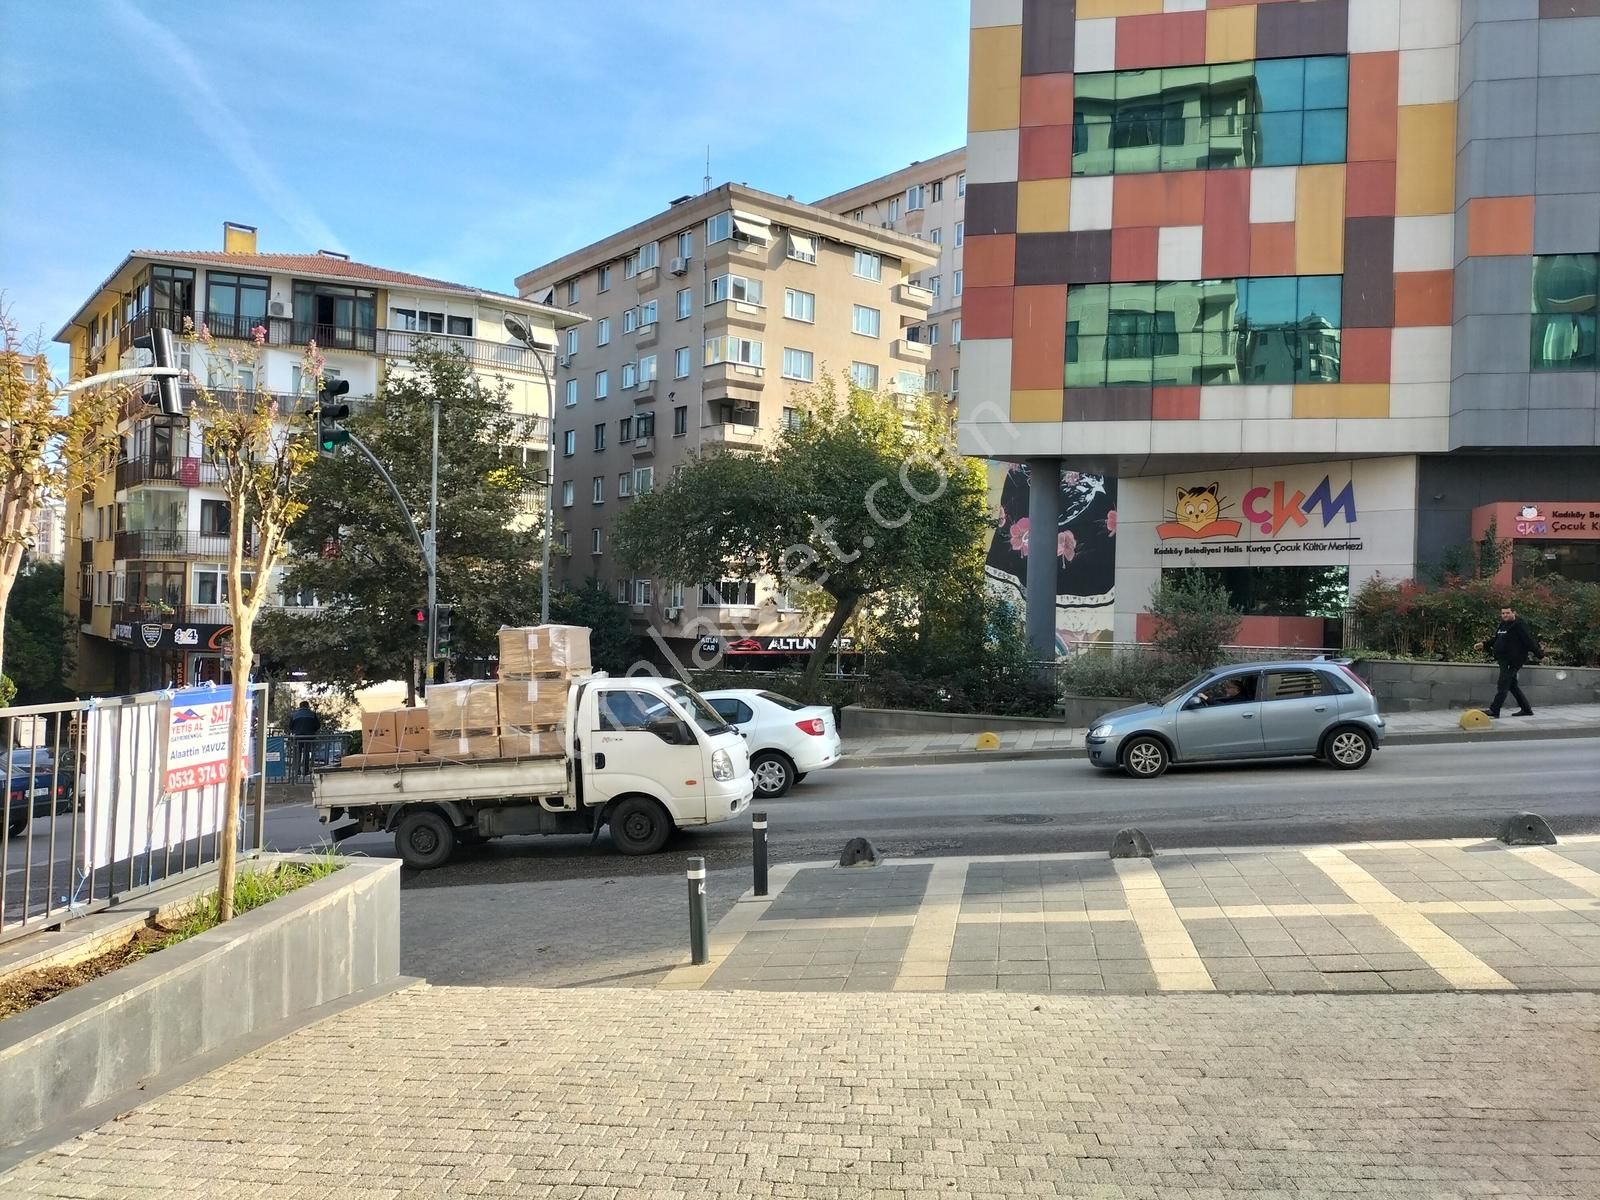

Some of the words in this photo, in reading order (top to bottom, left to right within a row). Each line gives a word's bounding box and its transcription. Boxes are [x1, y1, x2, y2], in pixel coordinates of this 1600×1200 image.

[1551, 511, 1585, 520] Kadıköy
[1551, 521, 1586, 532] Çocuk
[1154, 547, 1183, 556] Kadıköy
[1184, 546, 1222, 555] Belediyesi
[1223, 545, 1243, 553] Halis
[1246, 545, 1271, 554] Kurtça
[1273, 543, 1300, 554] Çocuk
[1302, 541, 1327, 551] Kültür
[1328, 541, 1362, 551] Merkezi
[768, 637, 817, 650] ALTUN
[170, 747, 199, 760] Alaattin
[201, 741, 226, 754] YAVUZ
[168, 768, 195, 789] 0532
[198, 765, 217, 783] 374
[698, 882, 706, 895] K
